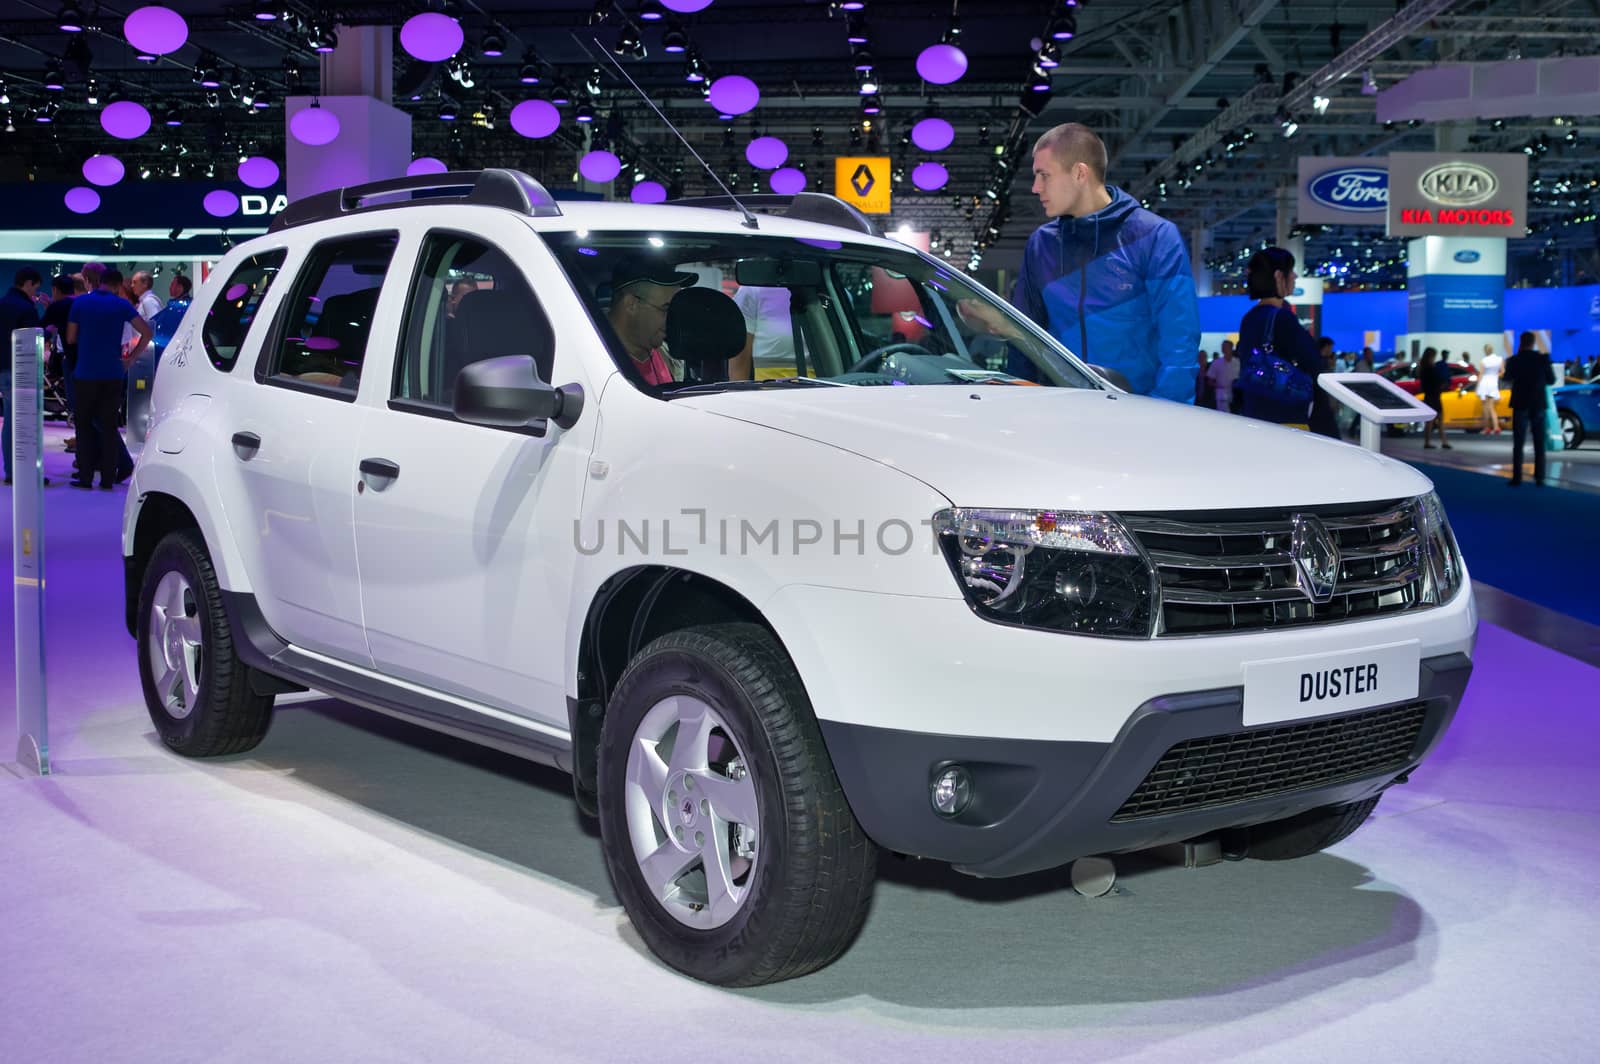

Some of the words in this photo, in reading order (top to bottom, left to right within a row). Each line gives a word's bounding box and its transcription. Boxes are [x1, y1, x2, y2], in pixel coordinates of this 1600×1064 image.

[1431, 174, 1482, 193] KIA
[1401, 208, 1433, 225] KIA
[1437, 207, 1515, 226] MOTORS
[1299, 663, 1378, 703] DUSTER
